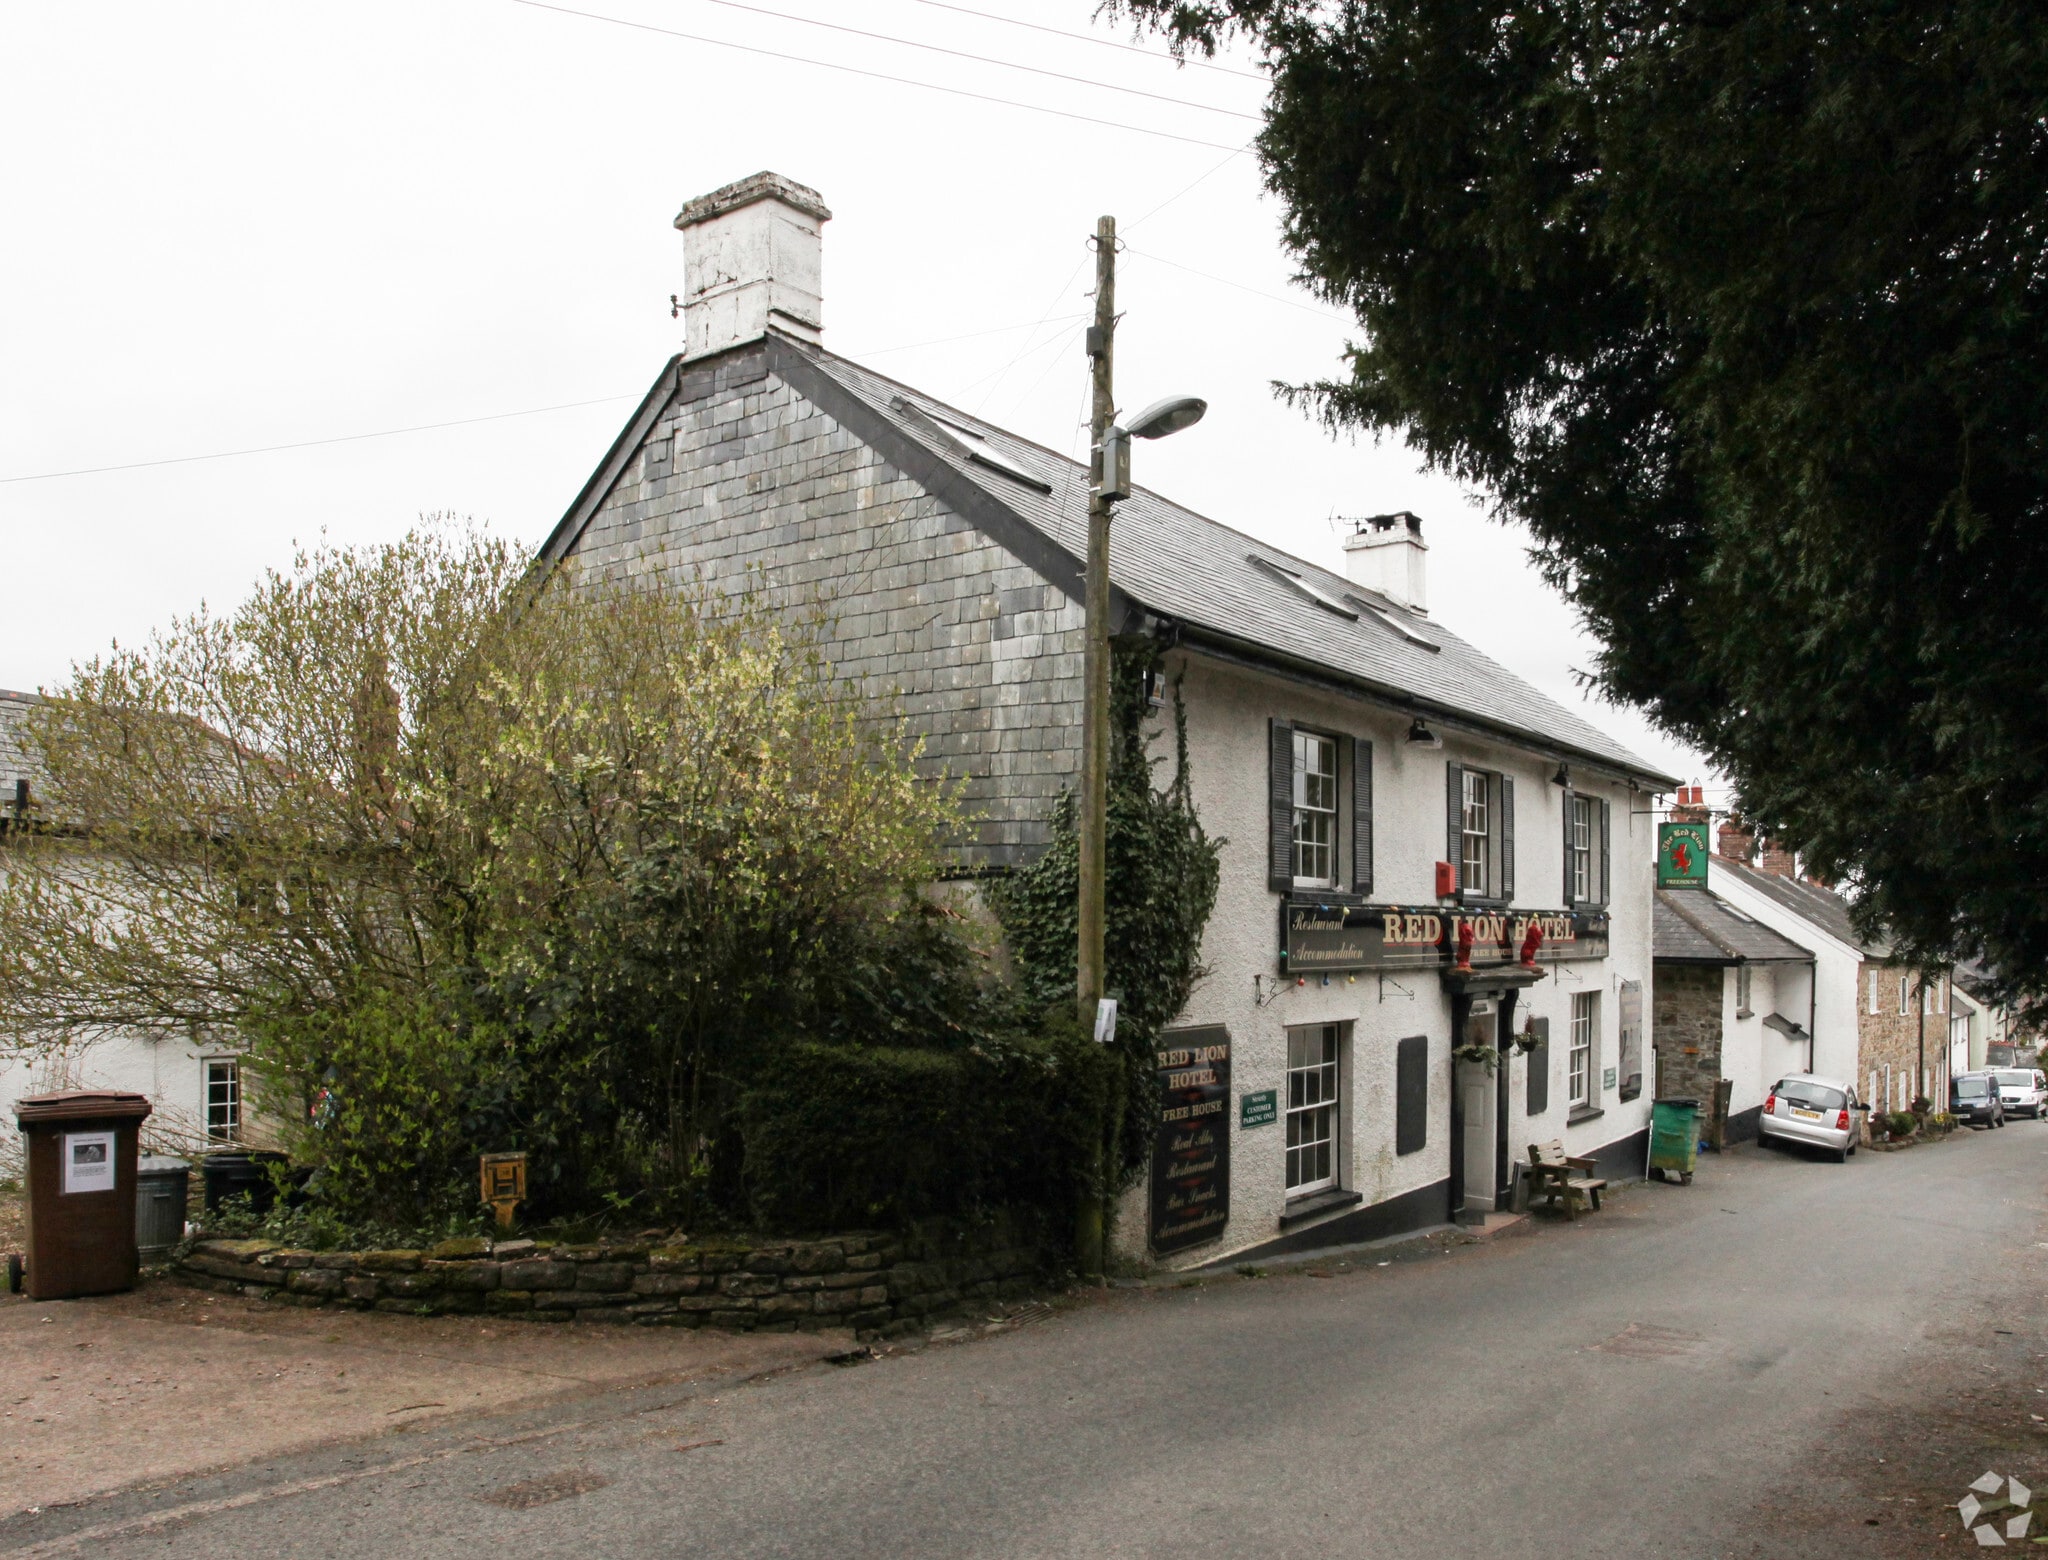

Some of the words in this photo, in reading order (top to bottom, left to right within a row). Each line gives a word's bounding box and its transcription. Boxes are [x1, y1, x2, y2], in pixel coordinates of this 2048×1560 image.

[1292, 911, 1345, 931] Restaurant
[1383, 914, 1442, 943] RED
[1292, 942, 1363, 961] Accommodation
[1158, 1050, 1189, 1067] RED
[1194, 1045, 1227, 1062] LION
[1169, 1069, 1216, 1088] HOTEL
[1163, 1107, 1189, 1122] FREE
[1192, 1100, 1222, 1116] HOUSE
[1247, 1104, 1271, 1114] CUSTOMER
[1243, 1114, 1262, 1124] PARKING
